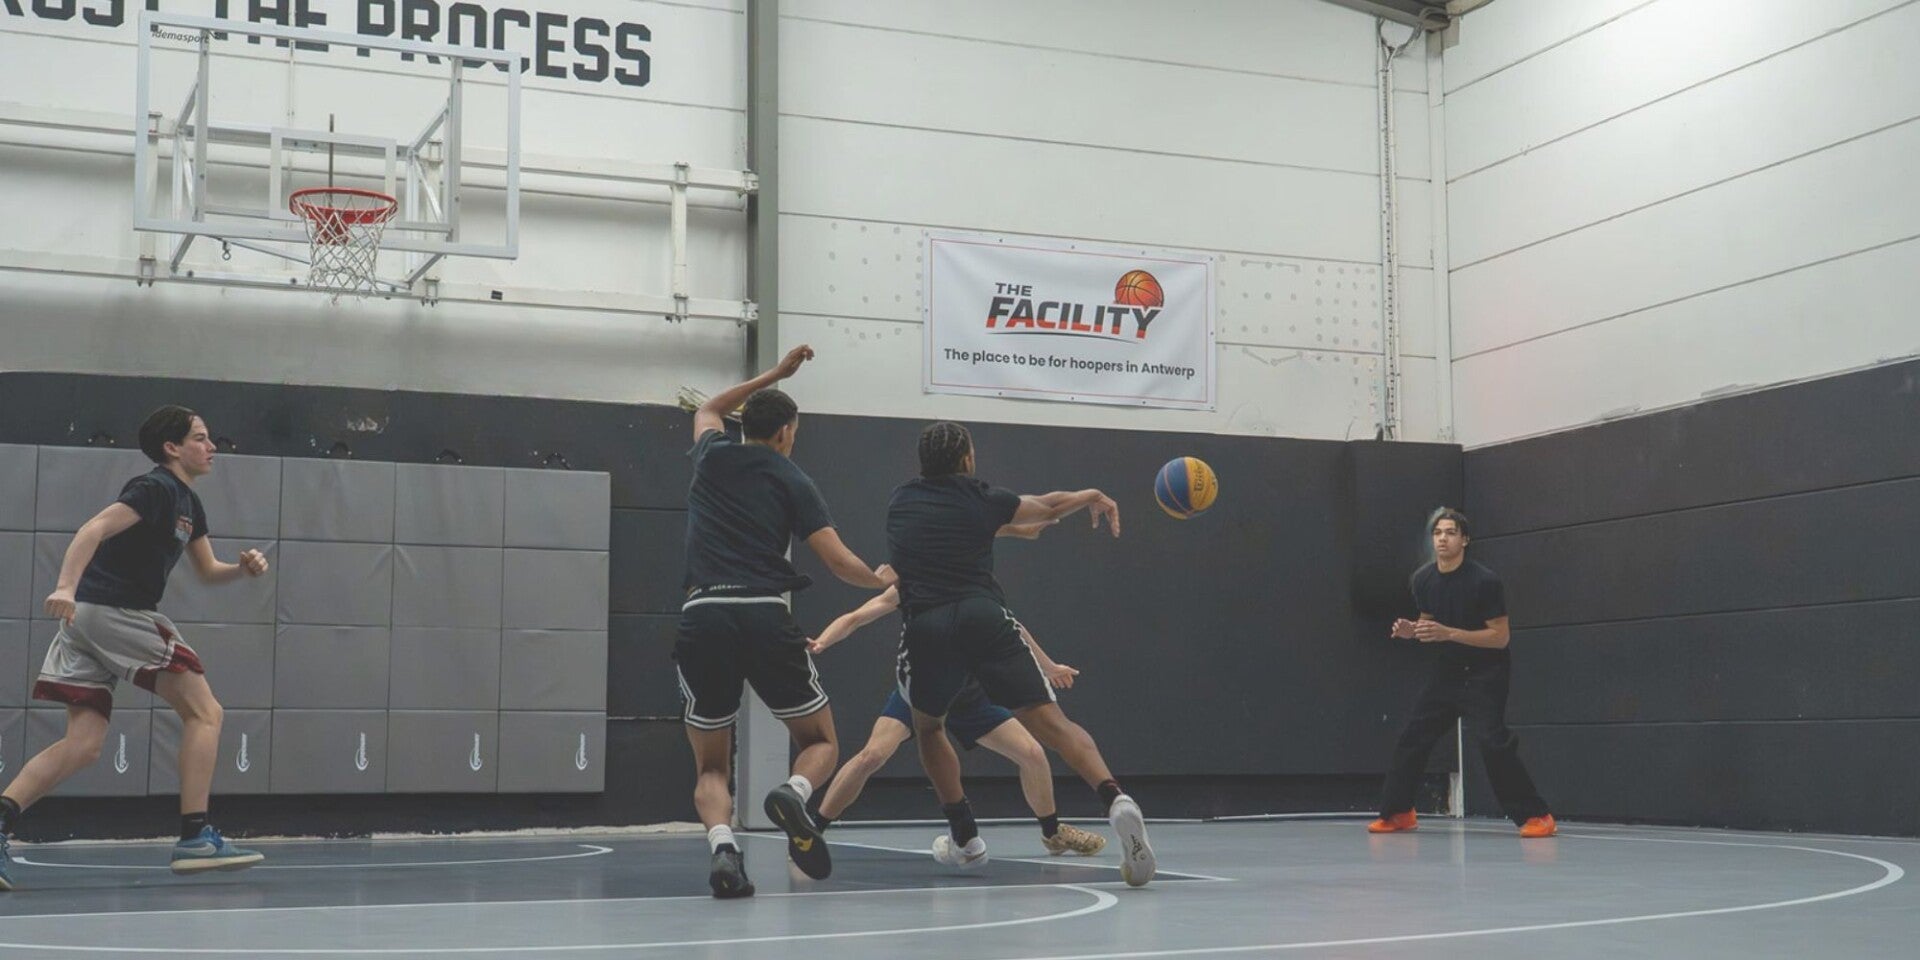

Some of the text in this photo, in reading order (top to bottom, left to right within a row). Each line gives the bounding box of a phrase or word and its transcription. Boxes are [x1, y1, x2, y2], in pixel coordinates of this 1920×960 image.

[357, 0, 651, 87] PROCESS
[995, 282, 1033, 297] THE
[985, 296, 1161, 339] FACILITY
[944, 348, 1196, 380] The place to be for hoopers in Antwerp
